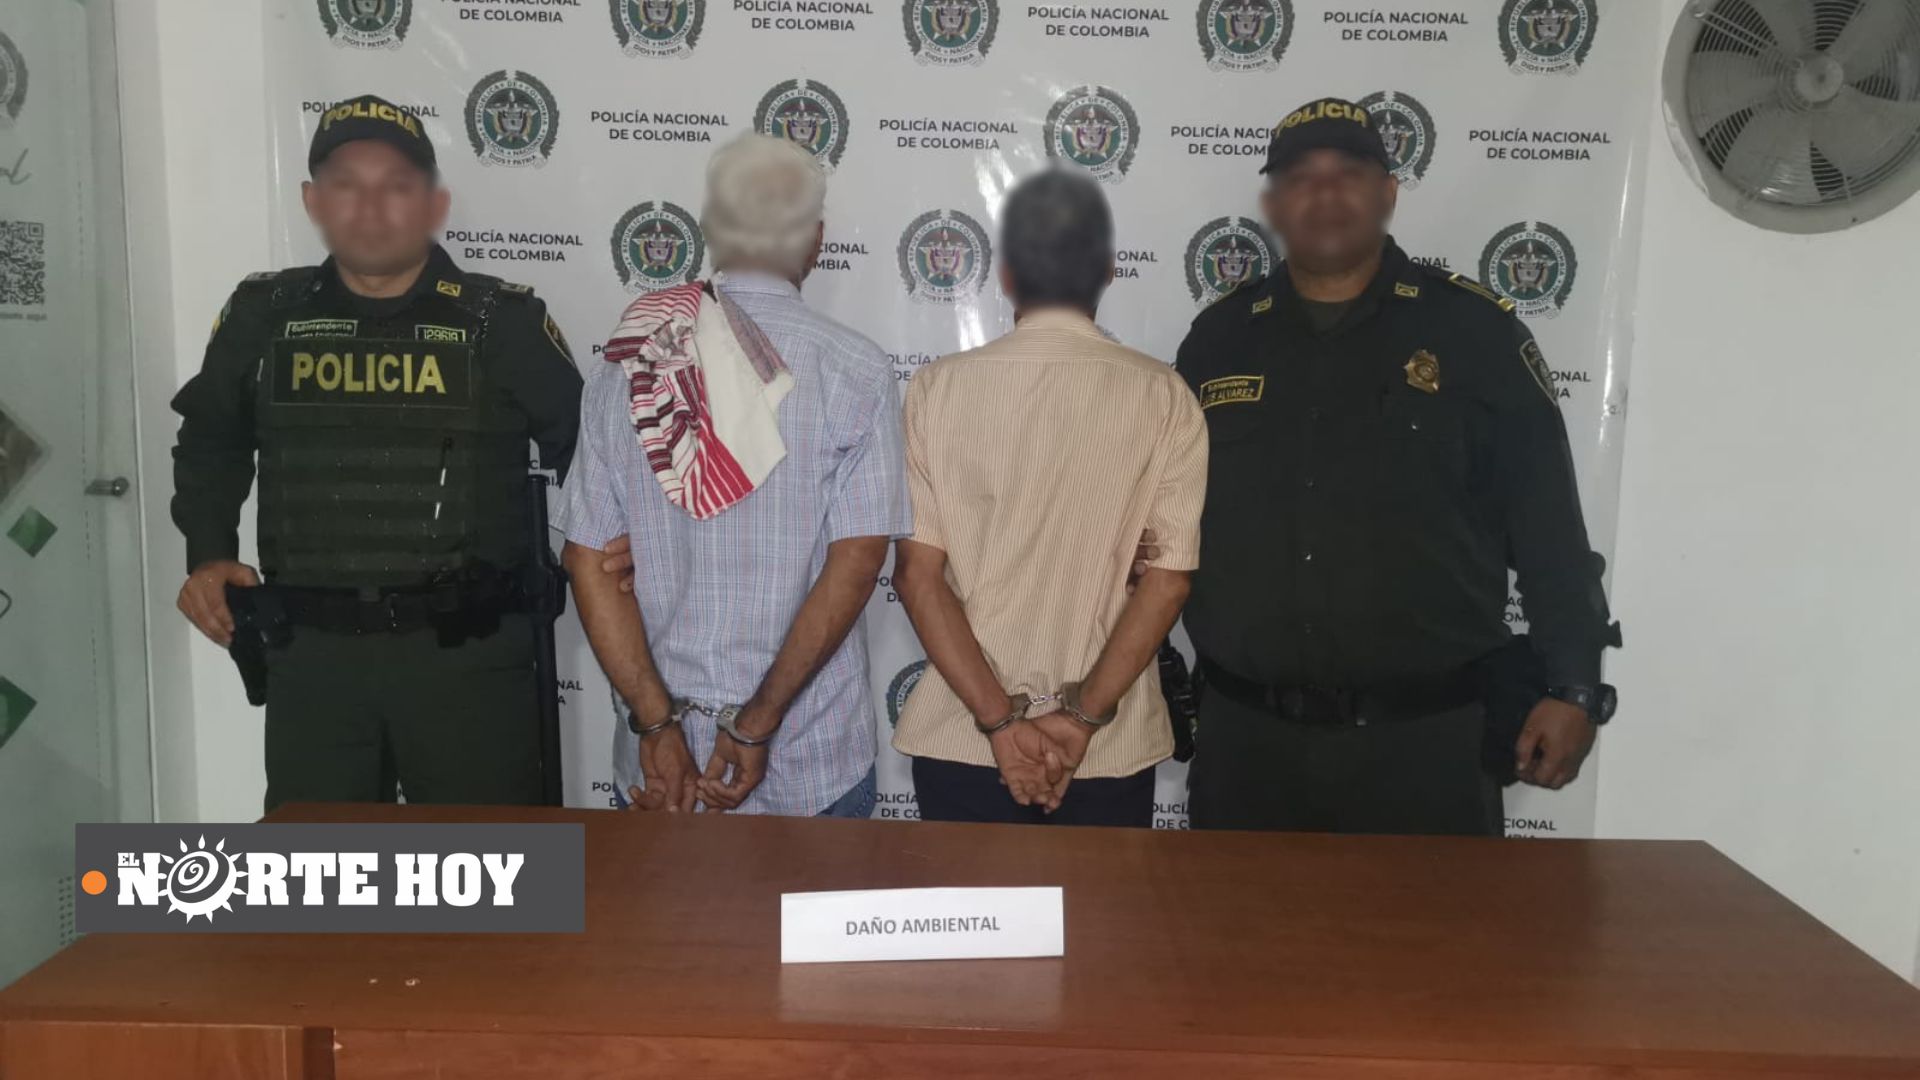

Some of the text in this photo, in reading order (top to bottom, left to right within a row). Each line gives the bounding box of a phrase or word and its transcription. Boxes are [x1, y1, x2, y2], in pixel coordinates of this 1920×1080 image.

[797, 2, 873, 14] NACIONAL
[1028, 7, 1169, 20] POLICÍA NACIONAL
[460, 9, 563, 22] DE COLOMBIA
[1324, 10, 1468, 24] POLICÍA NACIONAL
[752, 18, 854, 30] DE COLOMBIA
[1046, 25, 1149, 37] DE COLOMBIA
[1342, 29, 1448, 41] DE COLOMBIA
[324, 102, 420, 137] POLICIA
[591, 110, 728, 126] POLICÍA NACIONAL
[1275, 101, 1368, 138] POLICIA
[880, 118, 1017, 133] POLICÍA NACIONAL
[1171, 125, 1275, 139] POLICÍA NACI
[609, 129, 711, 142] DE COLOMBIA
[1469, 128, 1610, 143] POLICÍA NACIONAL
[897, 137, 999, 149] DE COLOMBIA
[1189, 144, 1267, 157] DE COLOM
[1487, 148, 1590, 160] DE COLOMBIA
[446, 230, 582, 245] POLICÍA NACIONAL
[465, 248, 565, 261] DE COLOMBIA
[1117, 250, 1158, 263] ONAL
[888, 351, 931, 366] OLICÍA
[292, 353, 447, 394] POLICIA
[1550, 371, 1591, 383] ONAL
[876, 792, 919, 805] OLICÍA
[881, 808, 900, 818] DE
[1157, 818, 1175, 829] DE
[1504, 818, 1557, 831] CIONAL
[846, 917, 1000, 935] DAÑO AMBIENTAL
